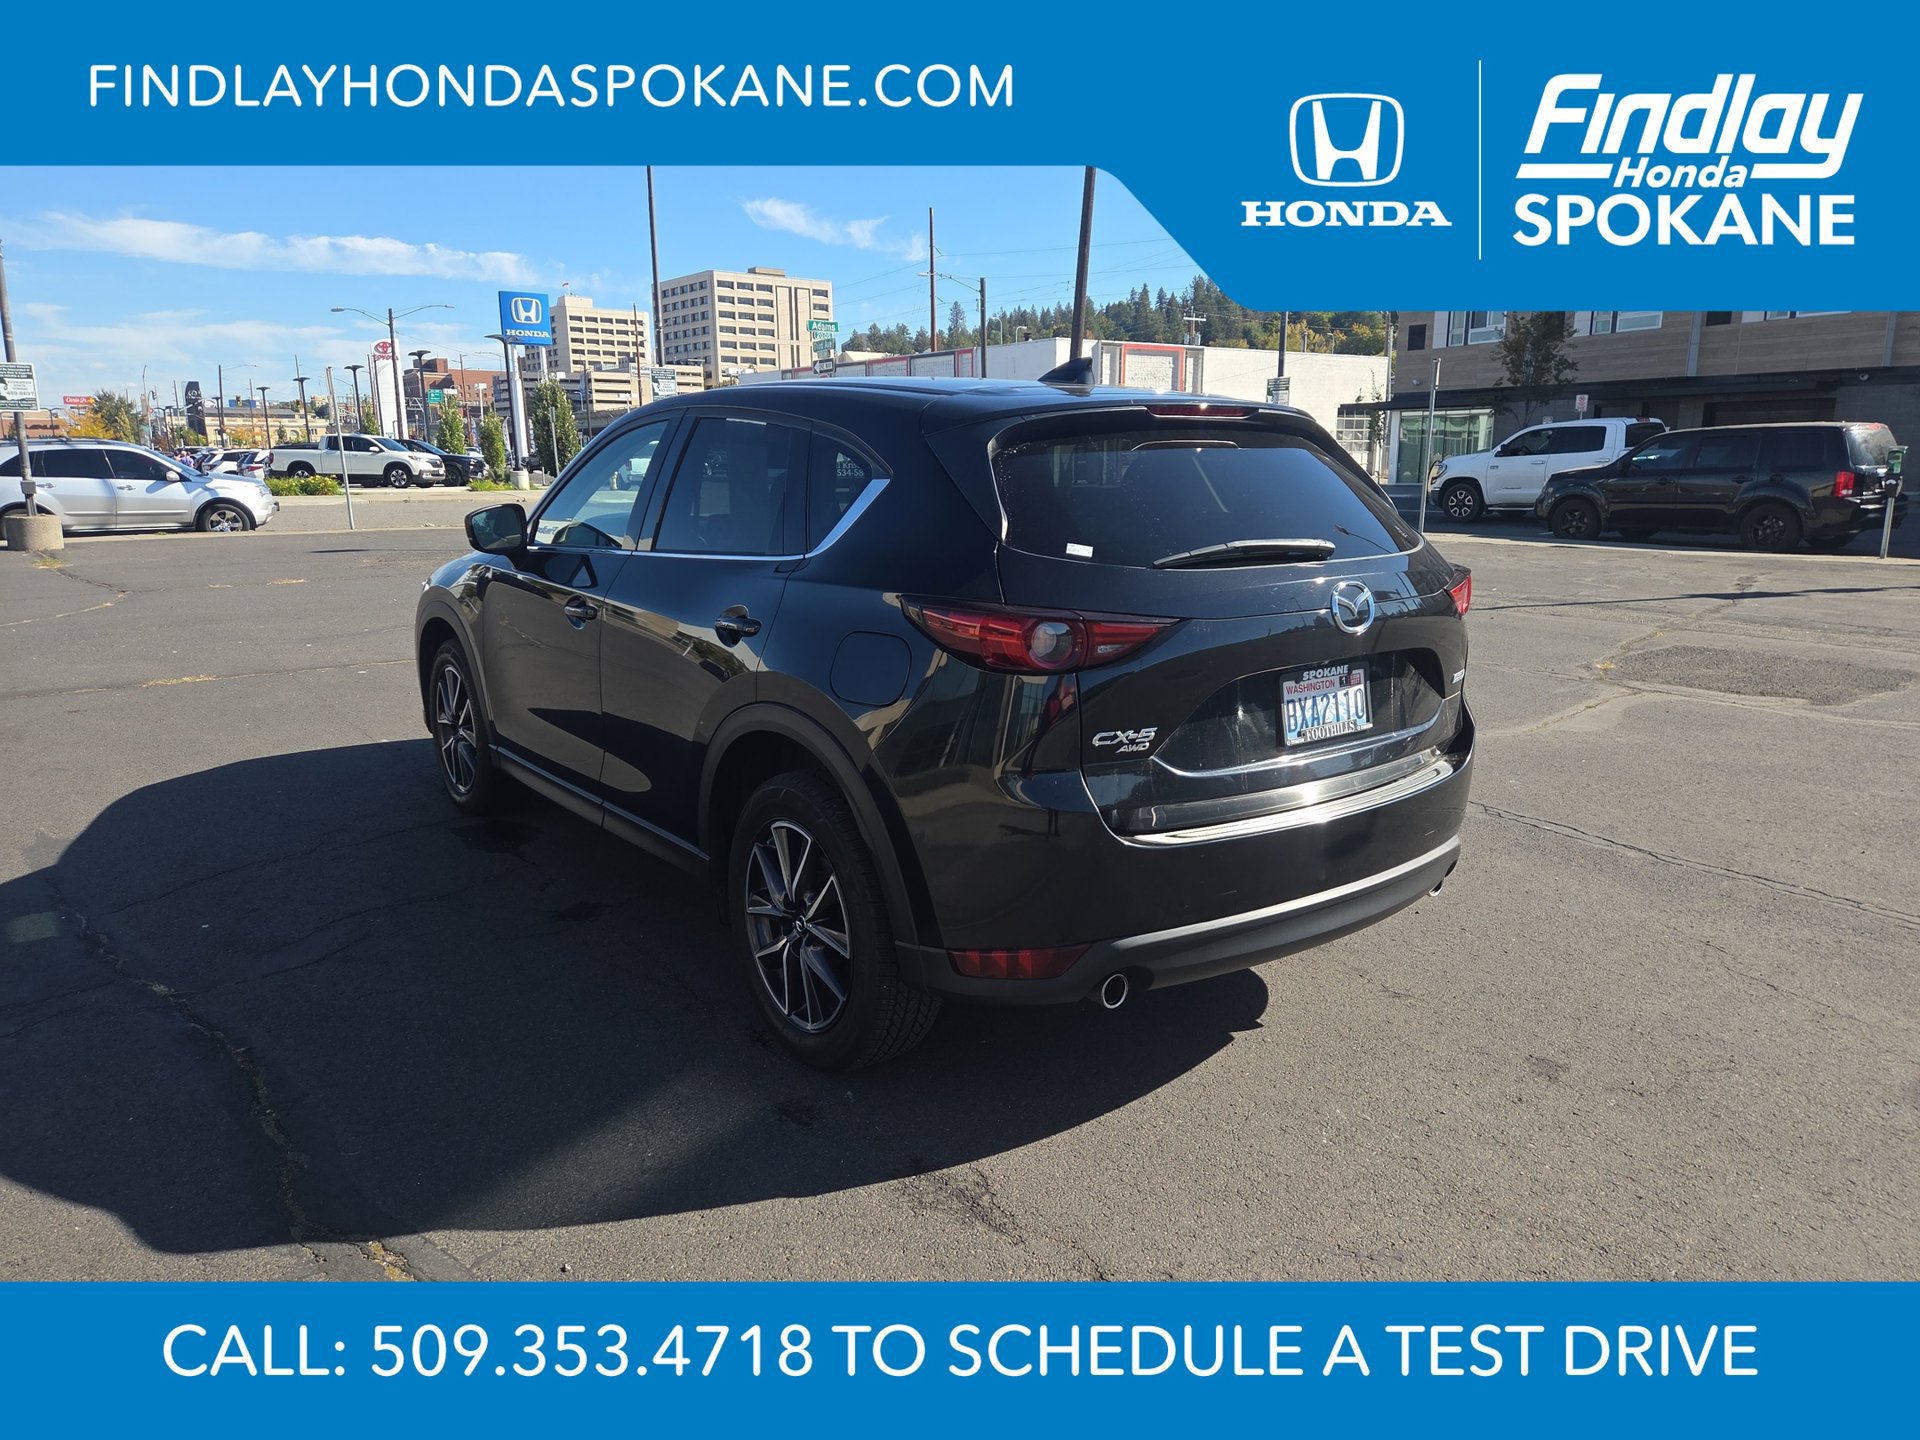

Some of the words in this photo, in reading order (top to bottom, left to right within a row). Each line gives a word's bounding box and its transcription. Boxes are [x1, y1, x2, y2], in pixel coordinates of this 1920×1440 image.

[506, 329, 550, 337] HONDA
[812, 321, 836, 331] Adams
[1302, 665, 1349, 681] SPOKANE
[1285, 679, 1335, 695] WASHINGTON
[1092, 727, 1158, 747] CX-5
[1305, 721, 1355, 741] FOOTHILLS
[1115, 742, 1150, 753] AWD
